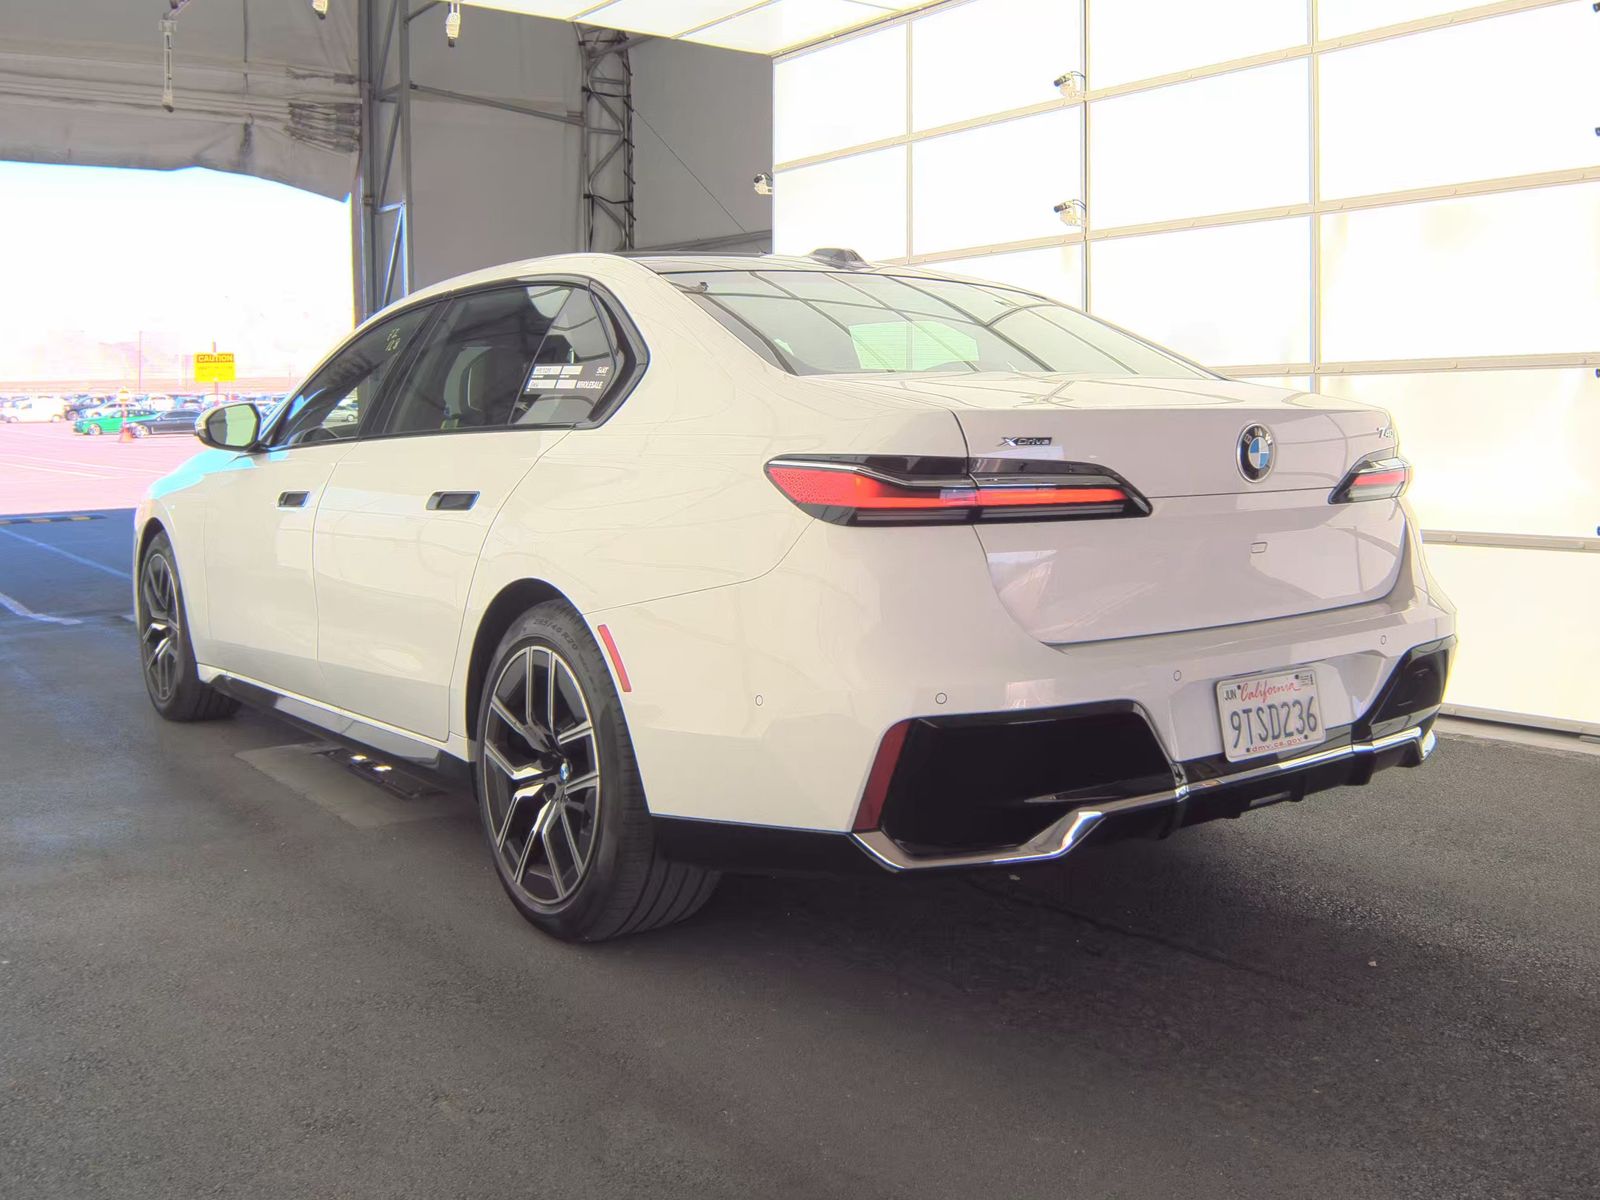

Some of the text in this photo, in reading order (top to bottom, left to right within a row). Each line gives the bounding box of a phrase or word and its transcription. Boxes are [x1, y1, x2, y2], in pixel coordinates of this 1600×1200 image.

[198, 354, 233, 362] CAUTION
[576, 381, 603, 389] WHOLESALE
[1243, 427, 1273, 445] BMW
[1224, 689, 1237, 701] JUN
[1240, 680, 1301, 703] California
[1230, 695, 1317, 749] 9TSD236
[1251, 737, 1303, 753] dmv.ca.gov
